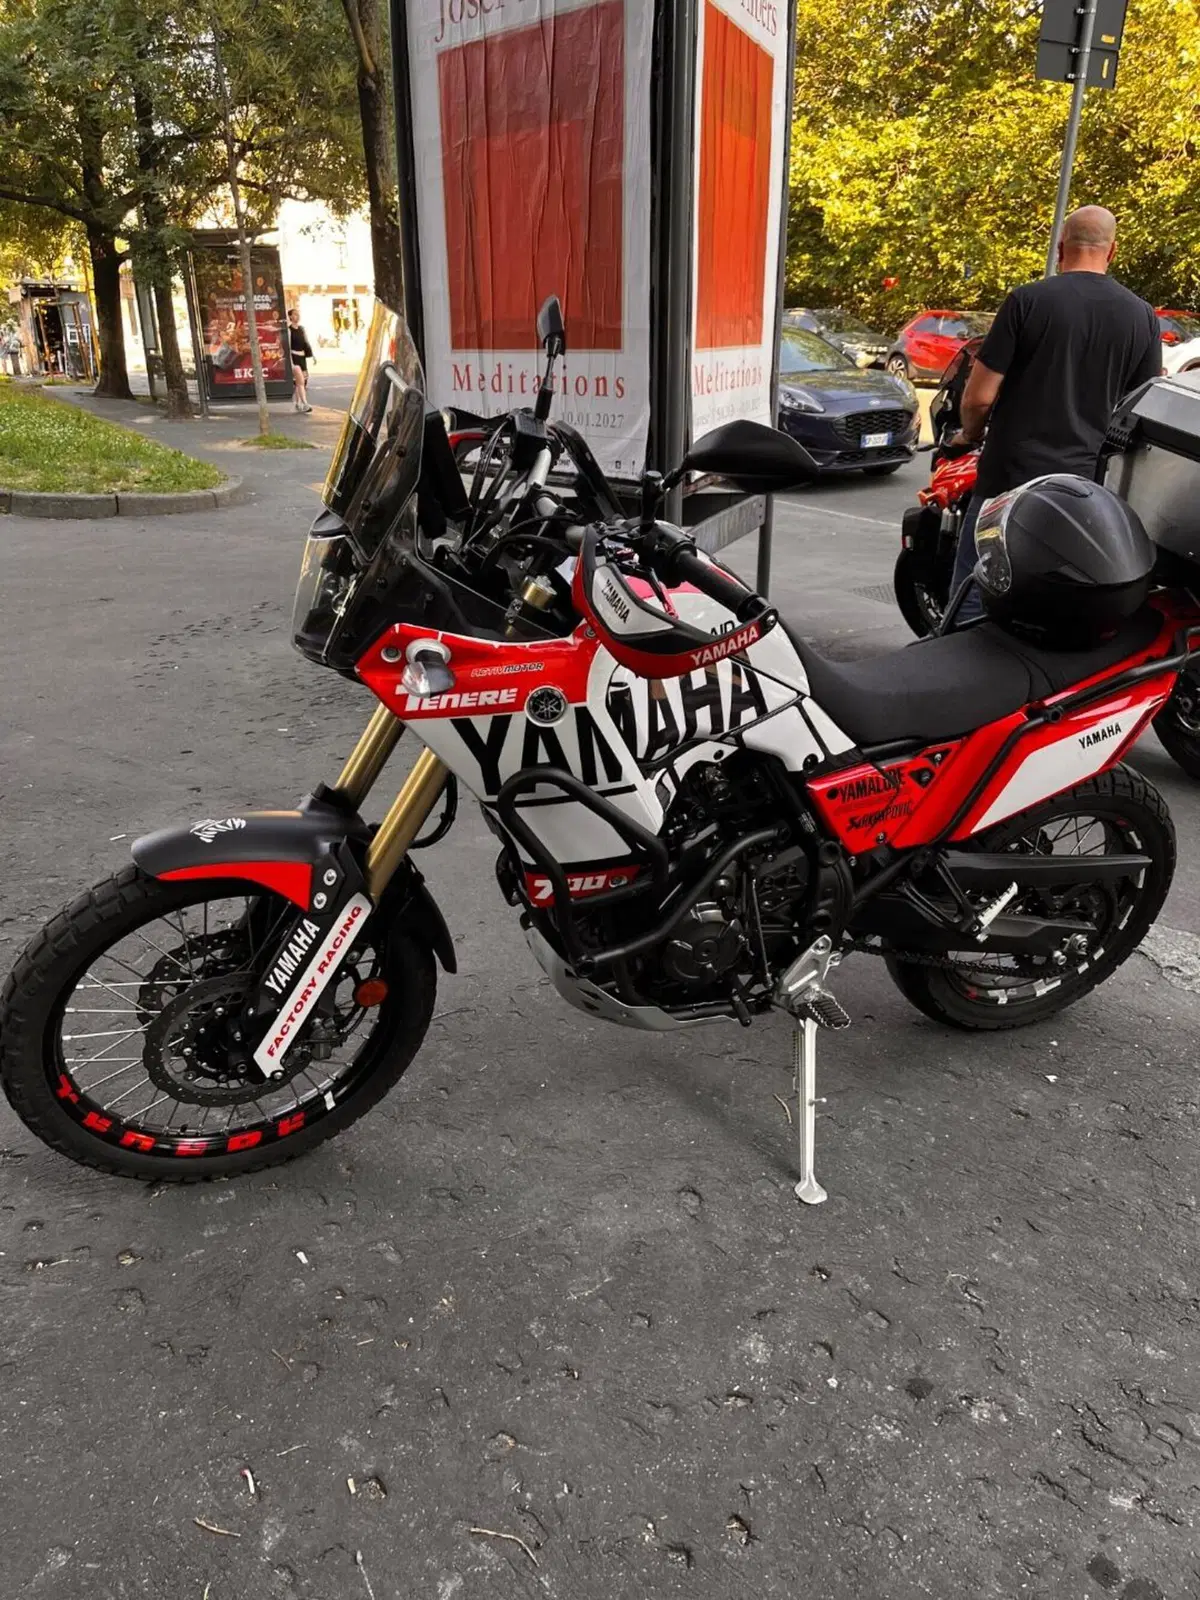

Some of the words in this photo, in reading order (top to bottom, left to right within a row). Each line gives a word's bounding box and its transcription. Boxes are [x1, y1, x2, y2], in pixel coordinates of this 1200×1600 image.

[601, 579, 631, 624] YAMAHA
[691, 625, 760, 667] YAMAHA
[1078, 722, 1122, 749] YAMAHA
[264, 917, 321, 995] YAMAHA
[266, 976, 318, 1058] FACTORY
[317, 905, 362, 976] RACING
